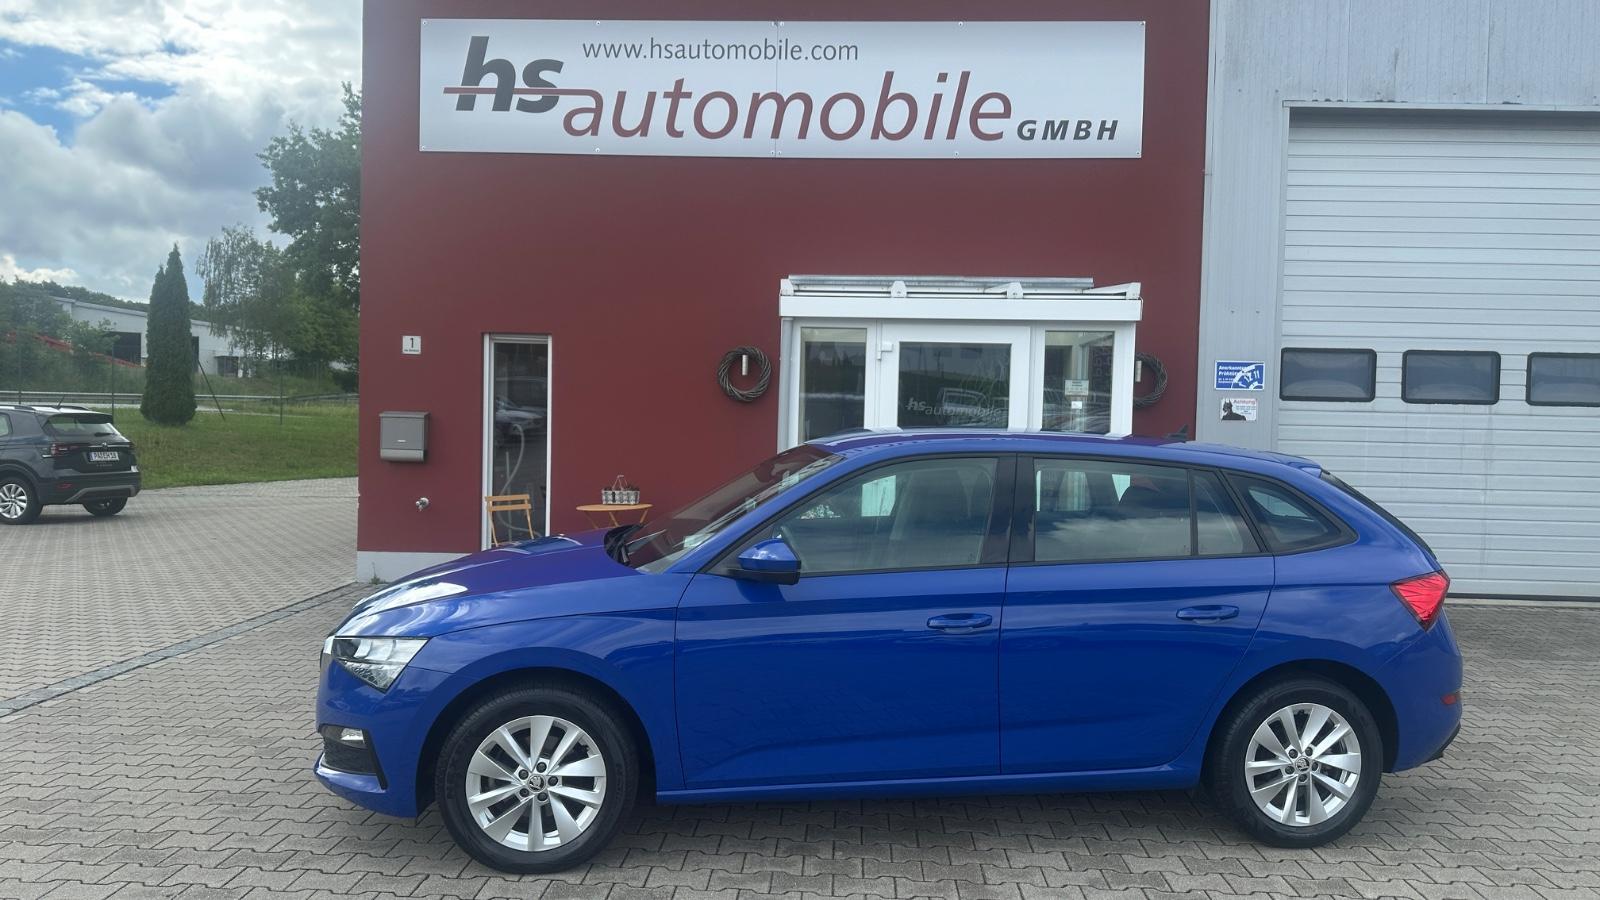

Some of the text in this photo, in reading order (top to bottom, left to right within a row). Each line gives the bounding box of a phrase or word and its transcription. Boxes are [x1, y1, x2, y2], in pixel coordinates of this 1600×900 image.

[582, 37, 858, 61] www.hsautomobile.com
[455, 35, 1119, 142] hs automobile GMBH
[410, 337, 415, 349] 1
